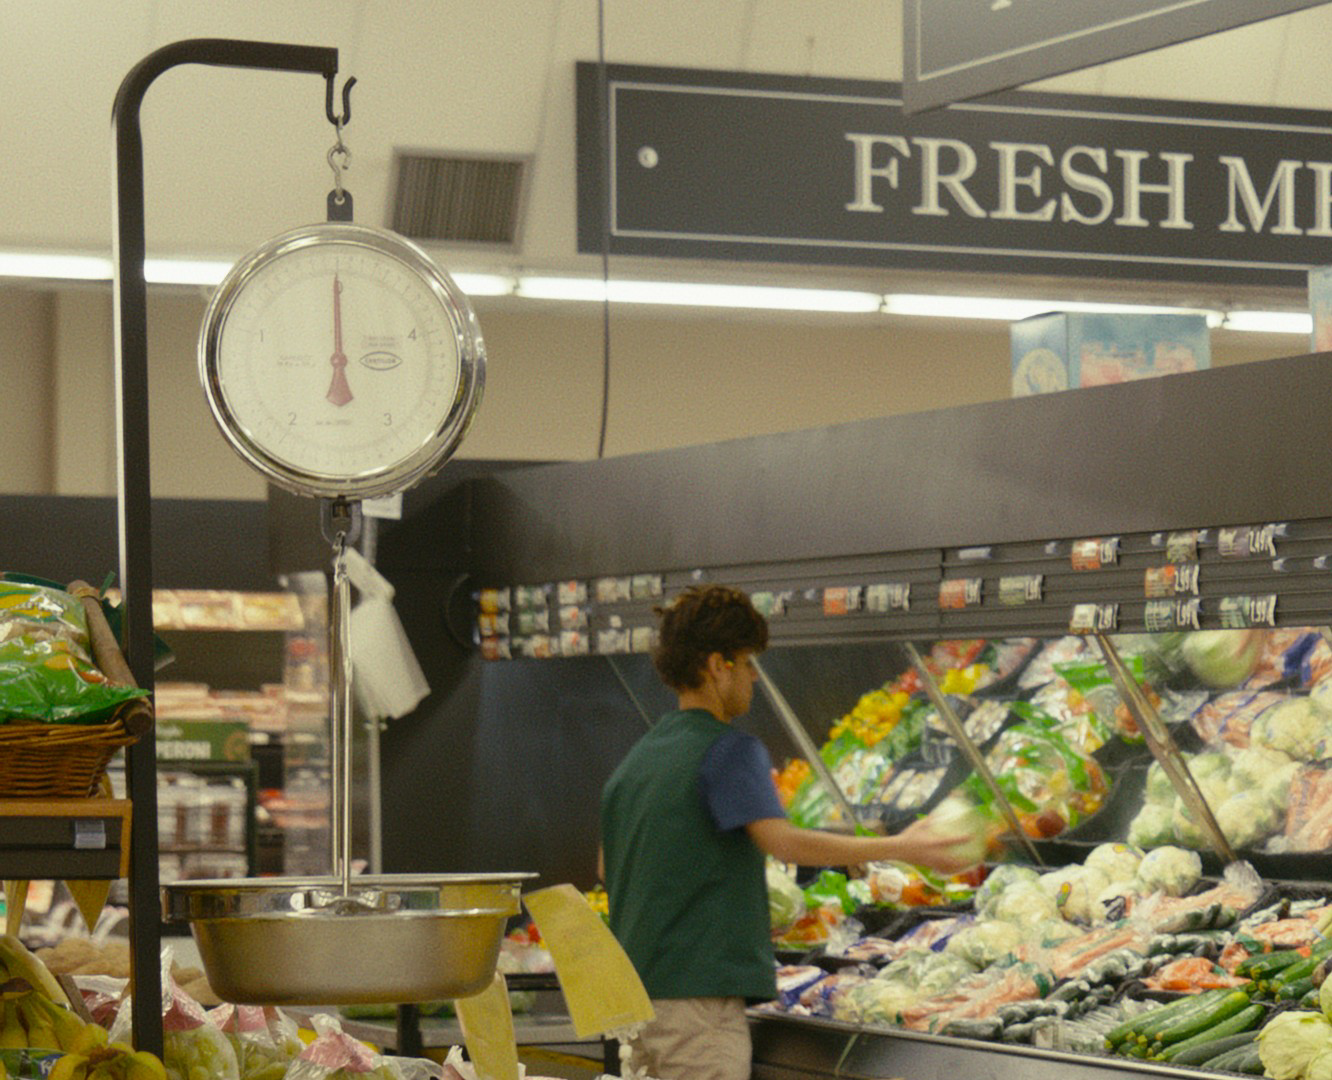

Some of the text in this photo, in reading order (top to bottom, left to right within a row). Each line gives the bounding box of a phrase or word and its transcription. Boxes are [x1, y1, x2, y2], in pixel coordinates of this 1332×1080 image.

[846, 132, 1195, 230] FRESH
[407, 327, 417, 341] 4
[287, 411, 298, 426] 2
[383, 412, 393, 426] 3
